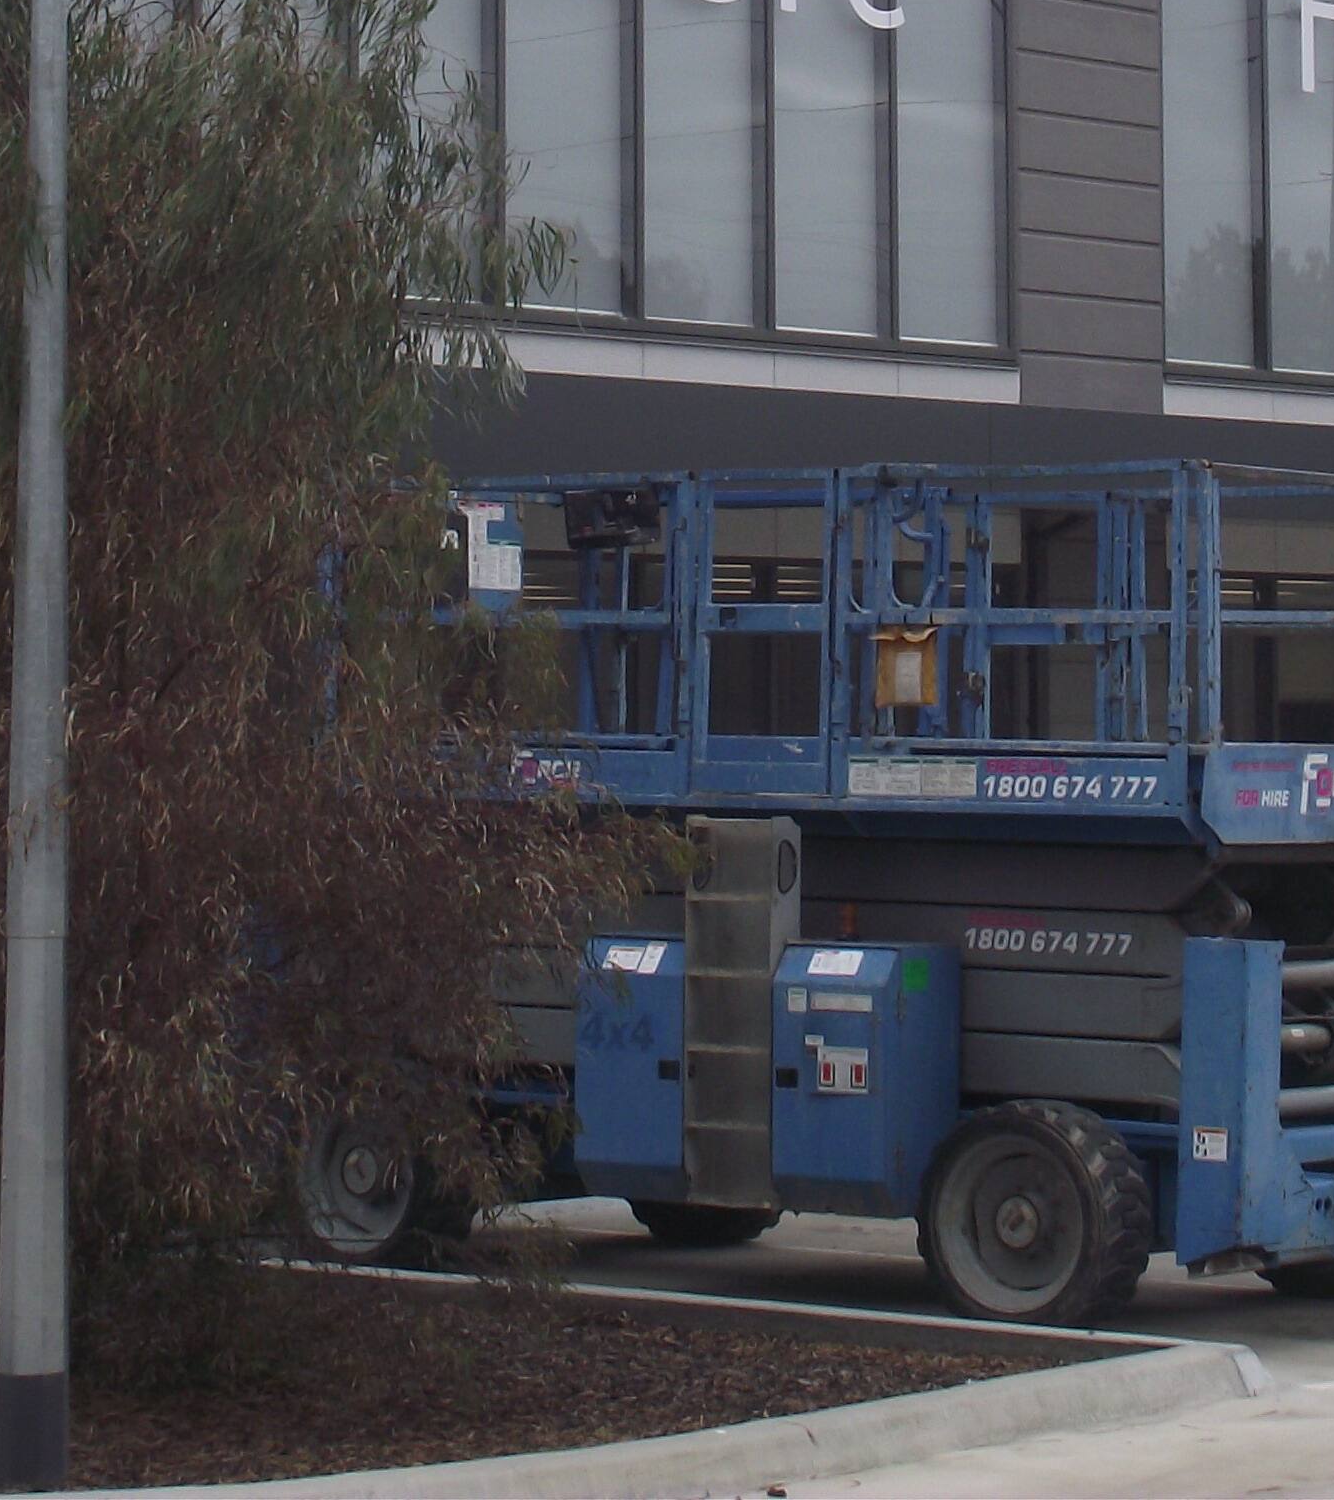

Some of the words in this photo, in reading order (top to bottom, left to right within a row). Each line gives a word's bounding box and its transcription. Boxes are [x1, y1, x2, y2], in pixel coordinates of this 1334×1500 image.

[983, 775, 1048, 798] 1800
[1052, 775, 1103, 798] 674
[1110, 775, 1158, 799] 777
[1261, 790, 1290, 807] HIRE
[965, 927, 1026, 951] 1800
[1030, 930, 1078, 953] 674
[1086, 932, 1132, 955] 777
